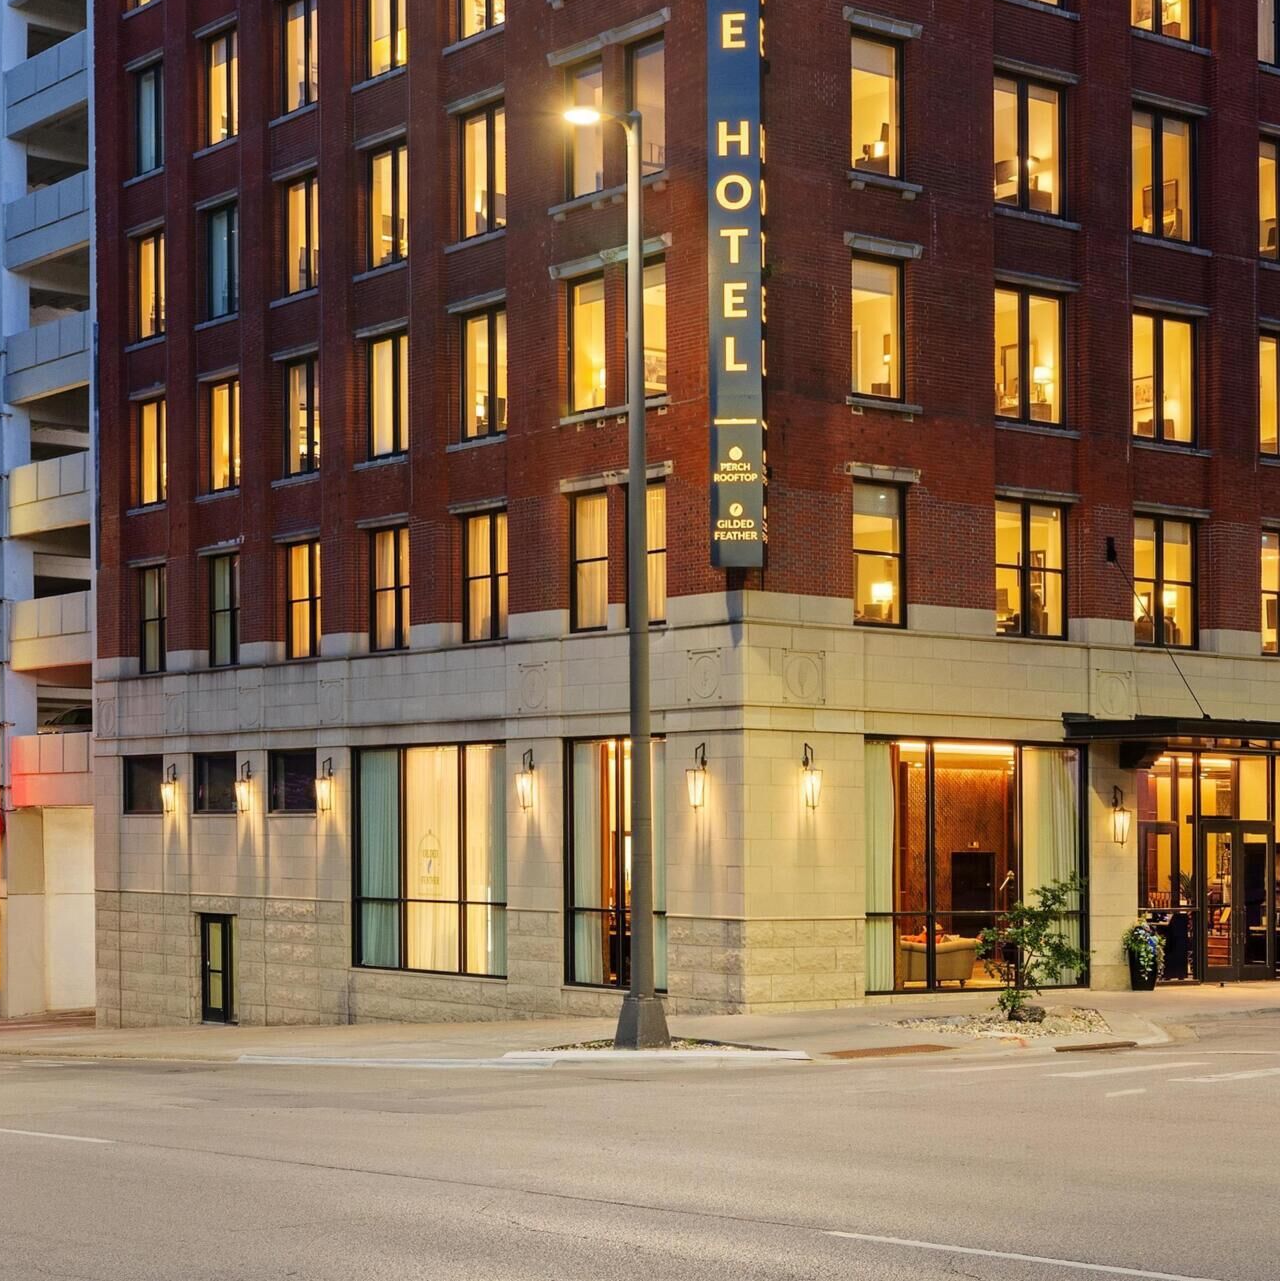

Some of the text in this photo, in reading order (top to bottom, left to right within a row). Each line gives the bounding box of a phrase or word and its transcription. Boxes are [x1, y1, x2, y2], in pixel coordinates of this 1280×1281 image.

[716, 121, 751, 372] HOTEL
[720, 462, 751, 472] PERCH
[714, 473, 758, 482] ROOFTOP
[717, 519, 754, 529] GILDED
[714, 531, 758, 541] FEATHER
